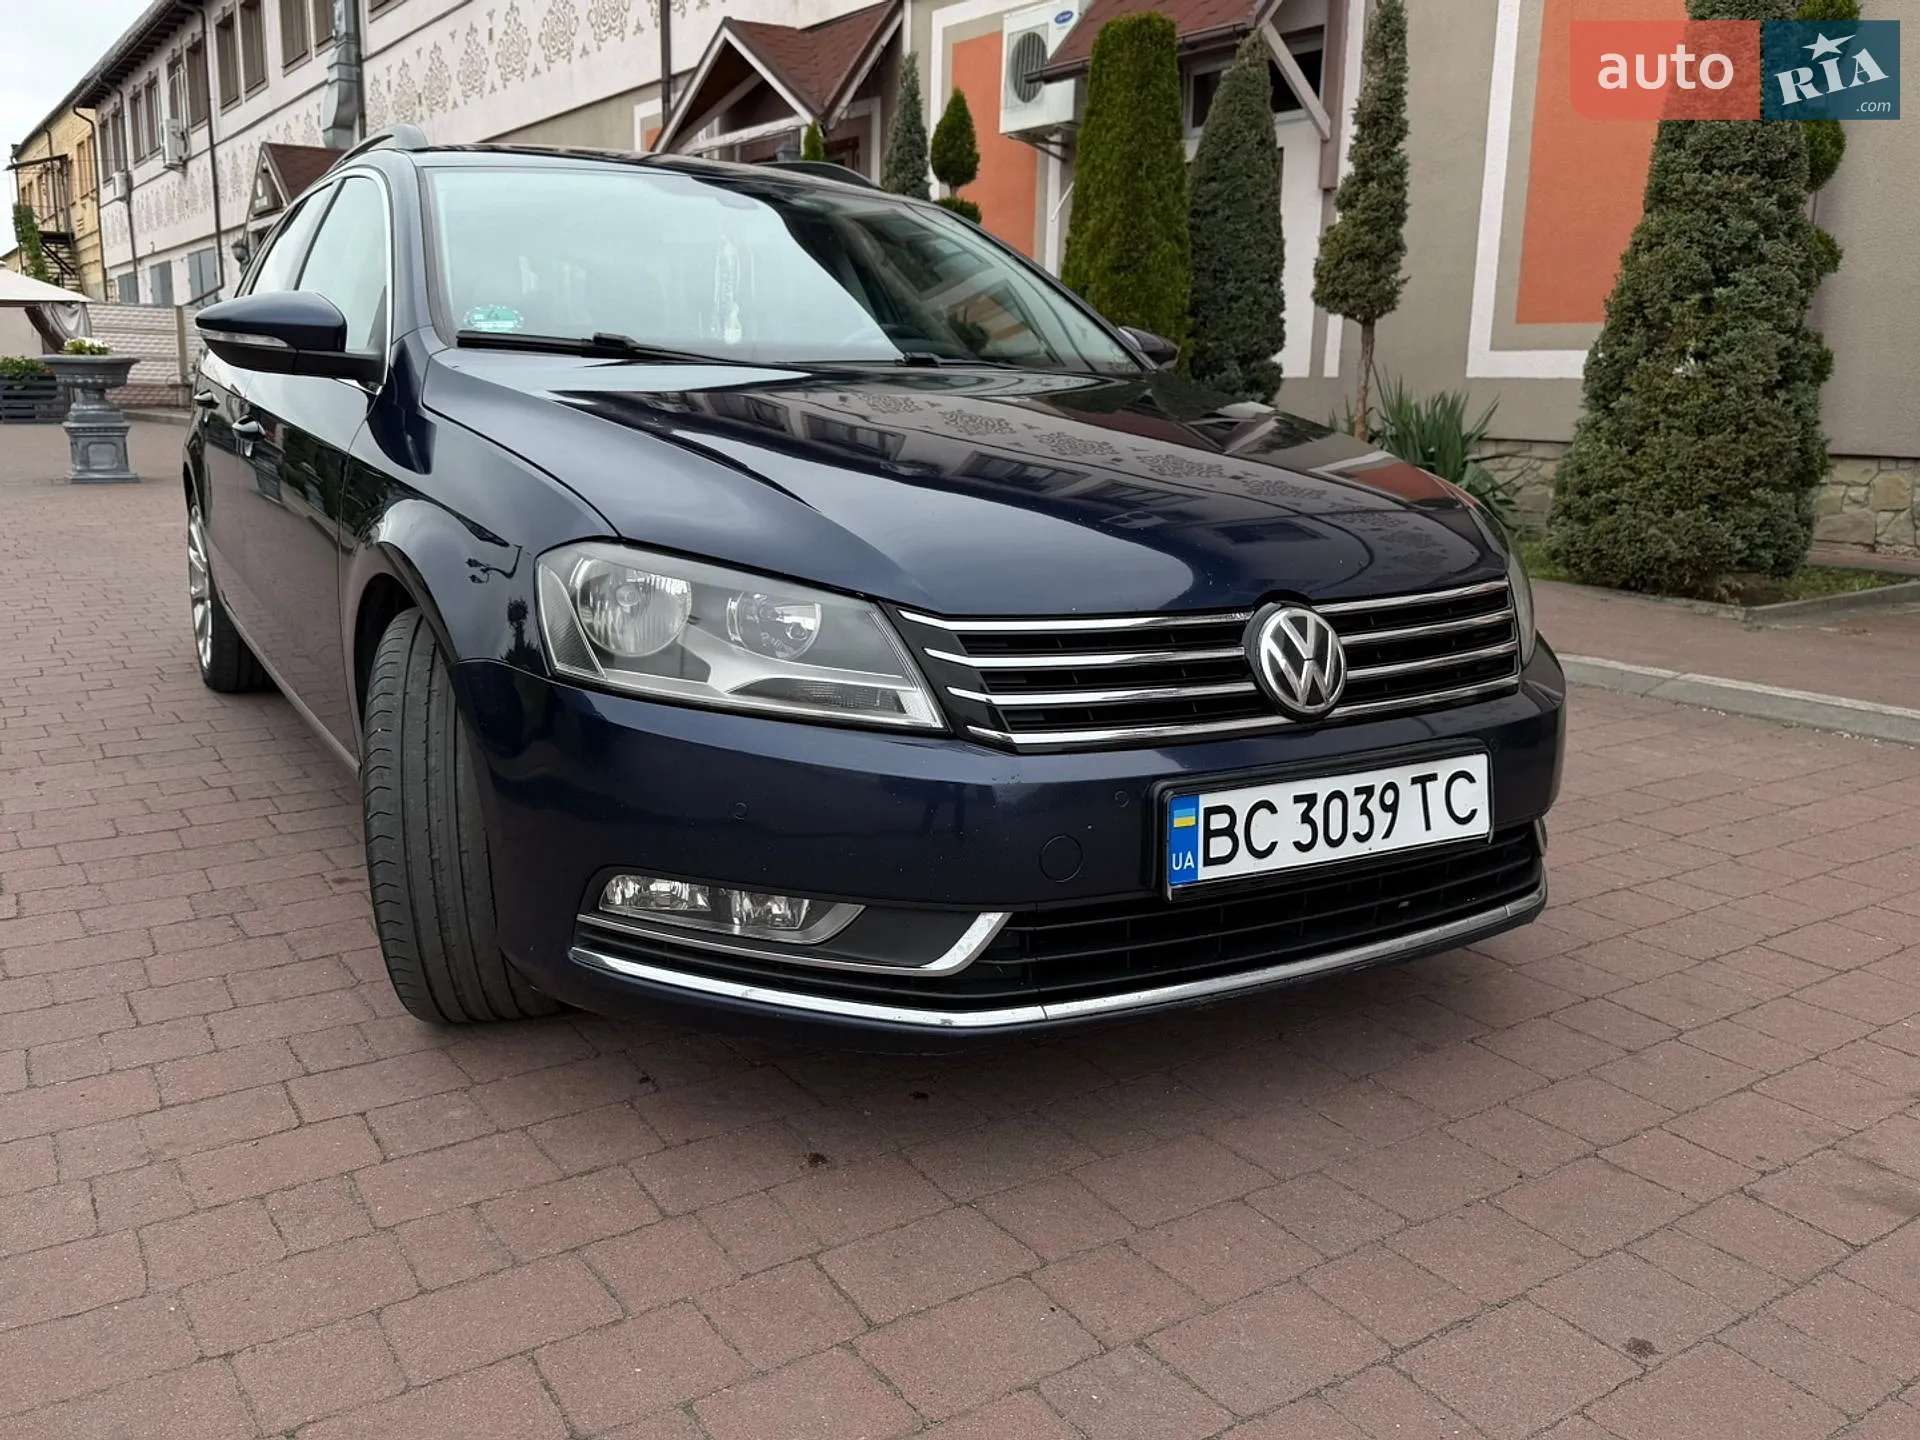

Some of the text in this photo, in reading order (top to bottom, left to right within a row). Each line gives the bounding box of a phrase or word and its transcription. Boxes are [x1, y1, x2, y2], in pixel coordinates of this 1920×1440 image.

[1202, 769, 1479, 867] BC 3039 TC
[1171, 850, 1195, 871] UA
